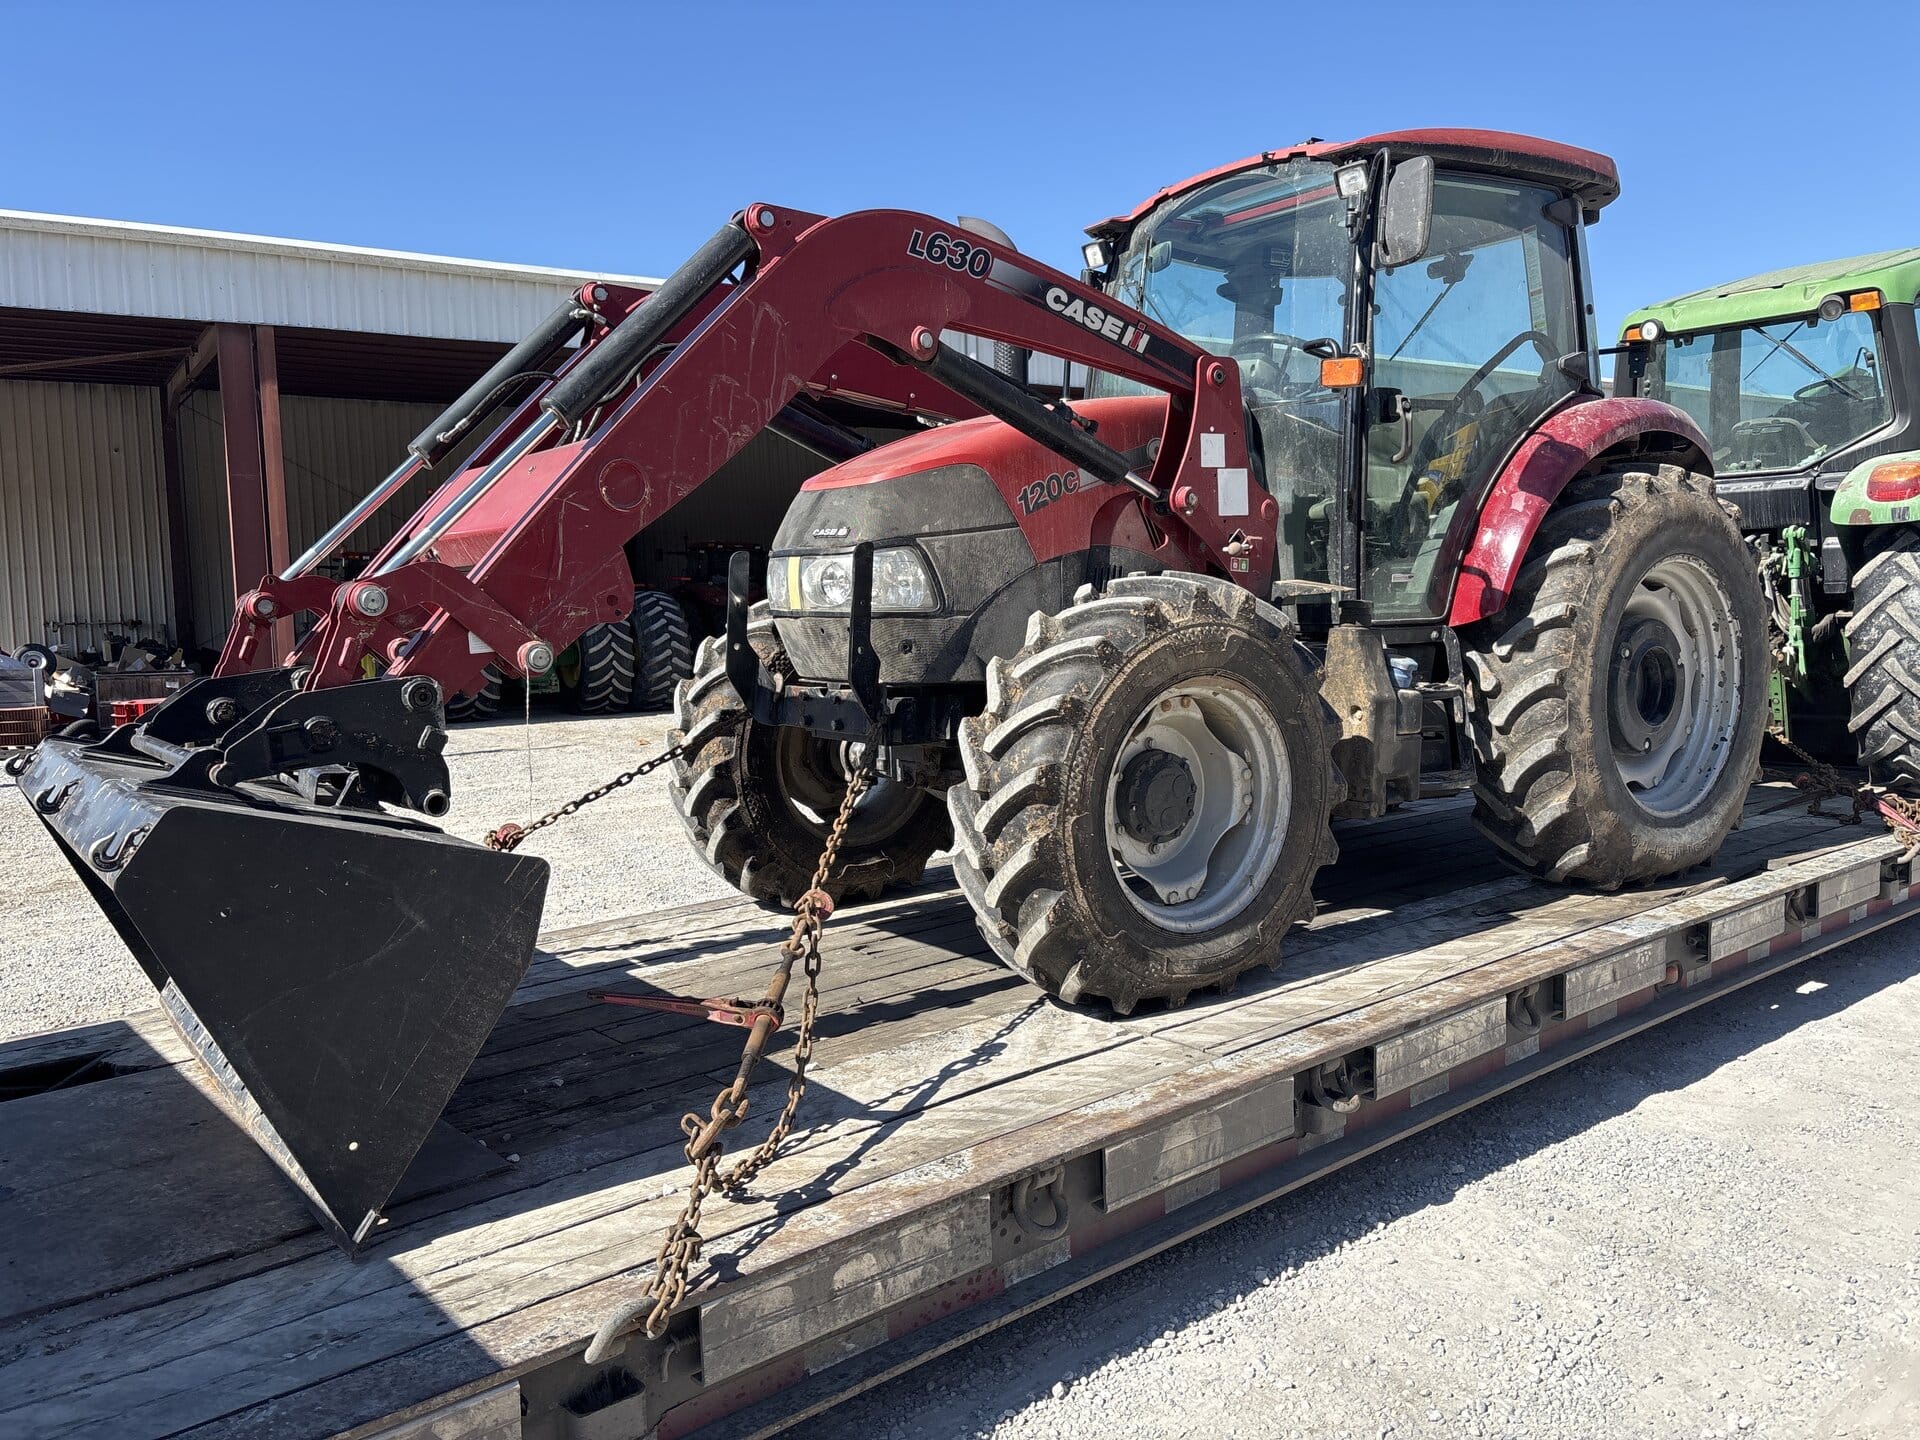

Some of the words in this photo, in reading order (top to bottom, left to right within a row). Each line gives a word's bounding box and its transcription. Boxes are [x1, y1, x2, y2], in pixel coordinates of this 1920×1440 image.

[907, 229, 992, 279] L630
[1046, 287, 1124, 341] CASE
[1017, 470, 1079, 516] 120C
[812, 527, 838, 536] CASE
